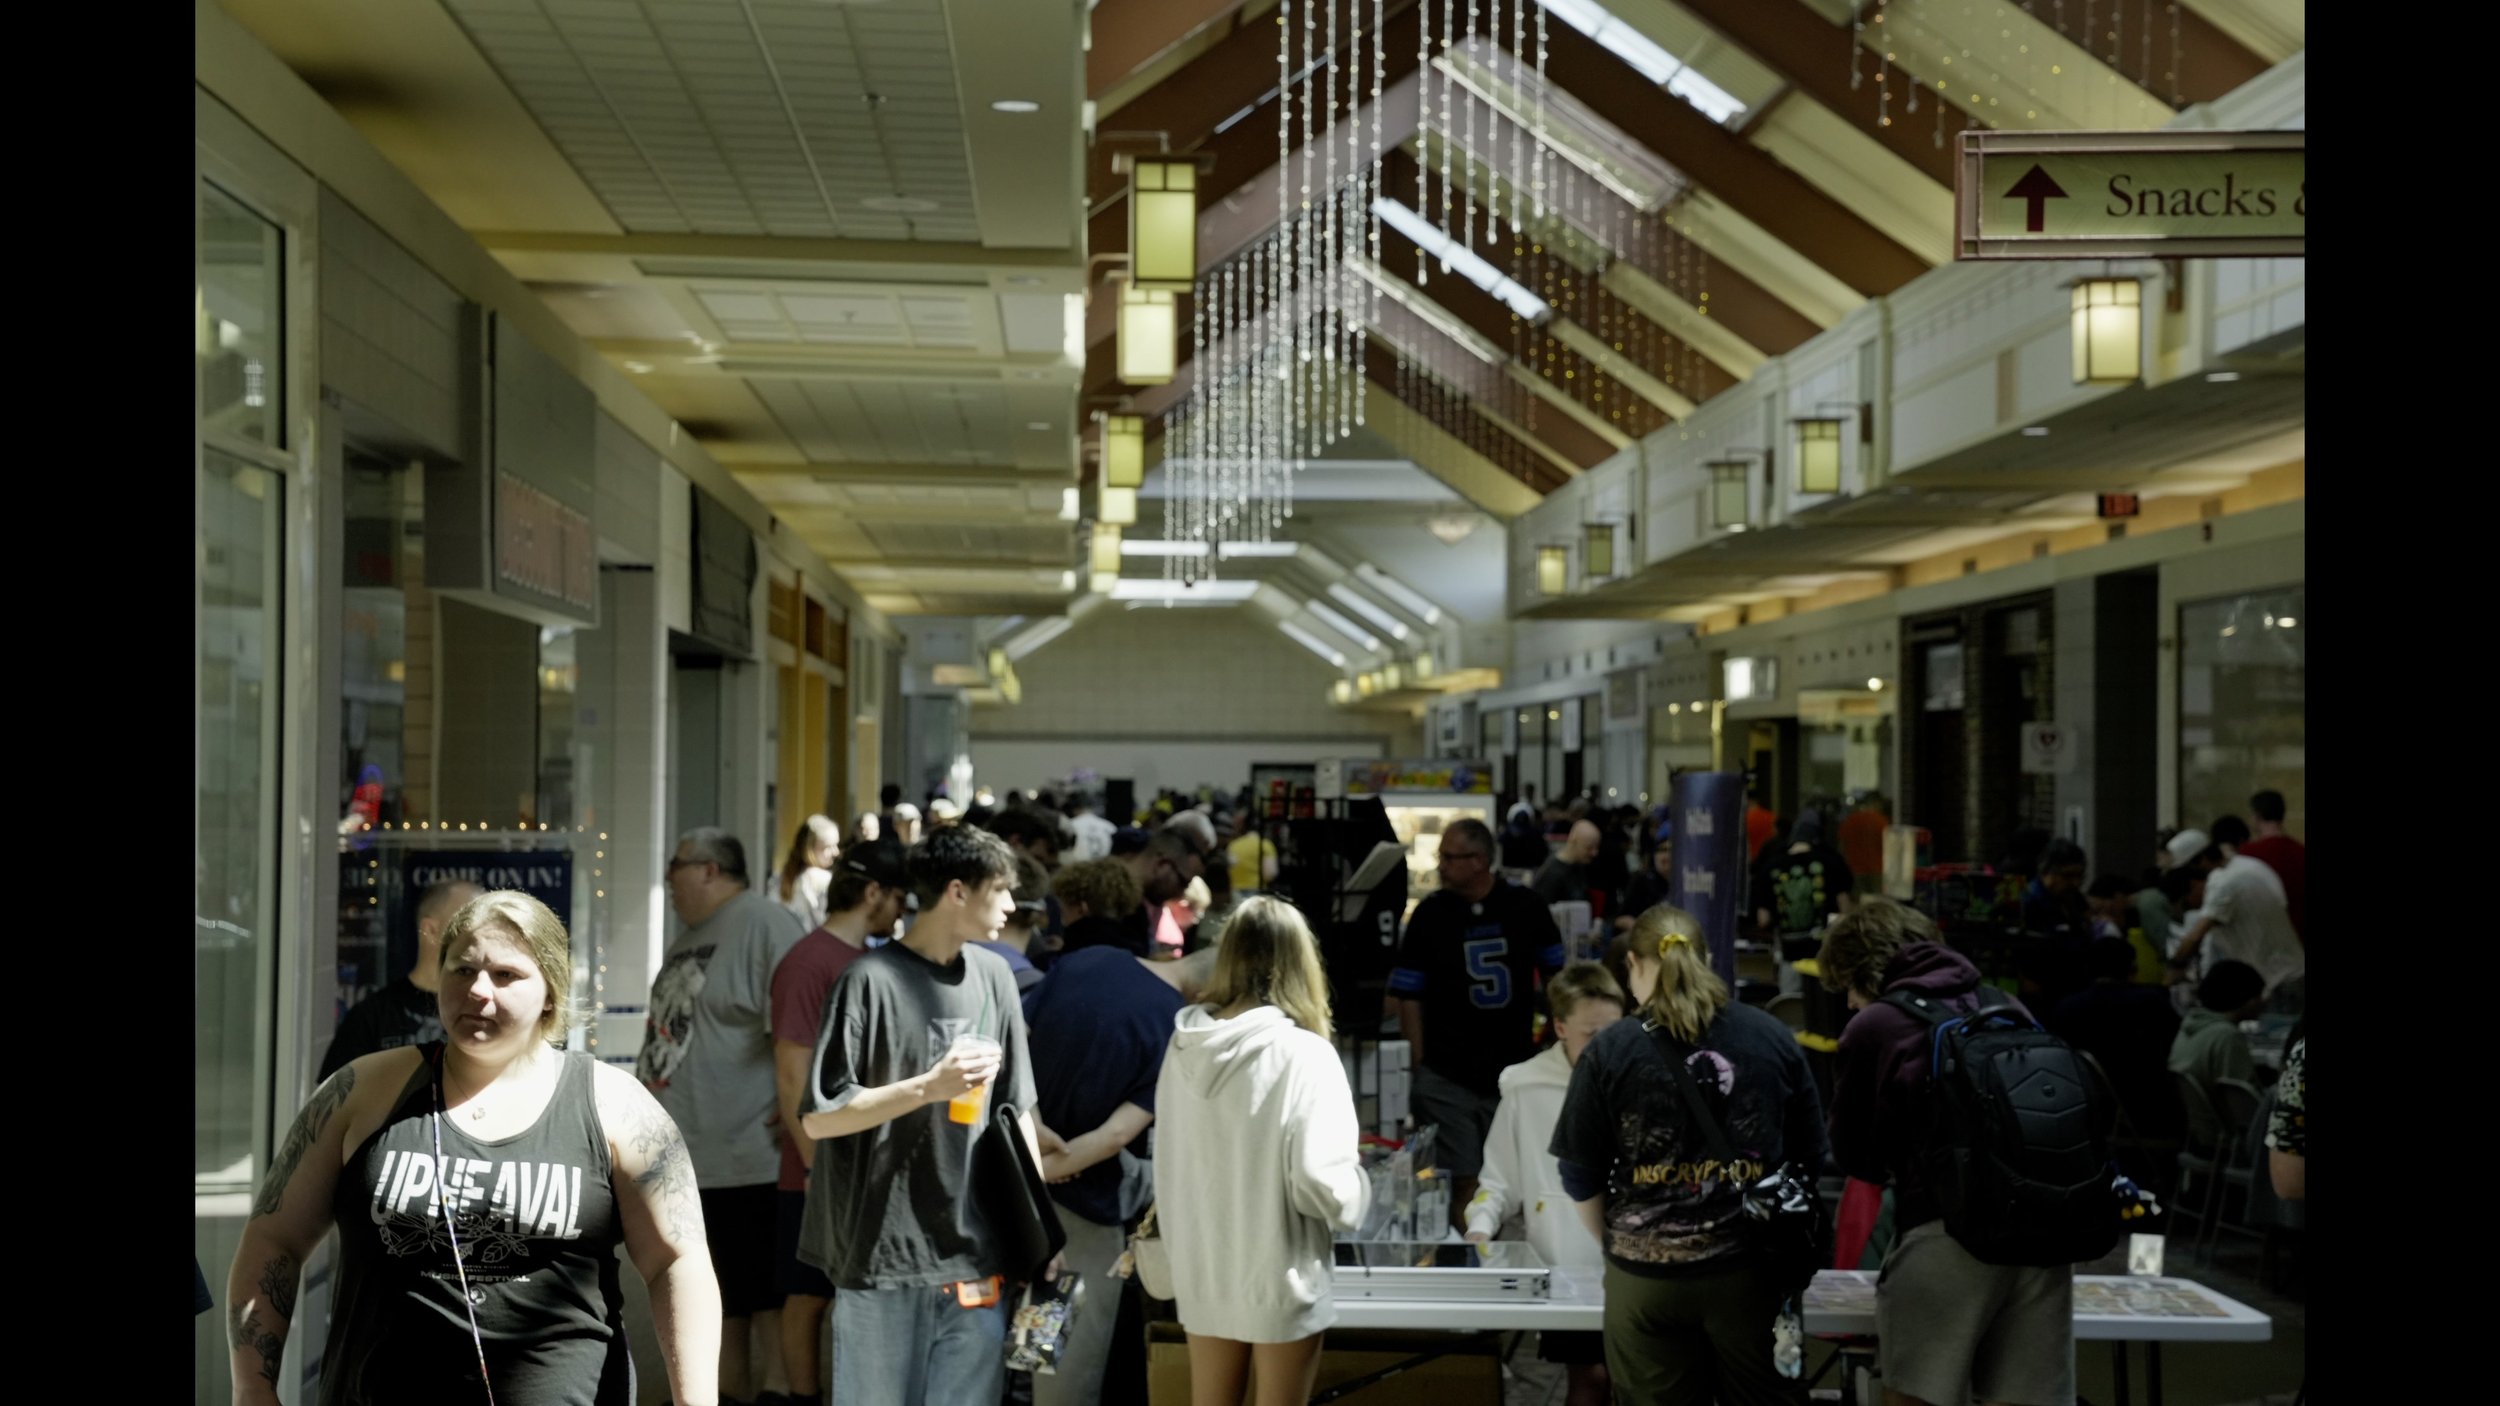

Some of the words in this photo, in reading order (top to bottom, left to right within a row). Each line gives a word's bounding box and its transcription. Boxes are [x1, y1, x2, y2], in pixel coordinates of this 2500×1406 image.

[2106, 172, 2277, 217] Snacks
[413, 866, 483, 888] COME
[487, 866, 527, 887] ON
[529, 865, 563, 888] IN!
[1463, 937, 1512, 1009] 5
[371, 1150, 583, 1240] UPHEAVAL
